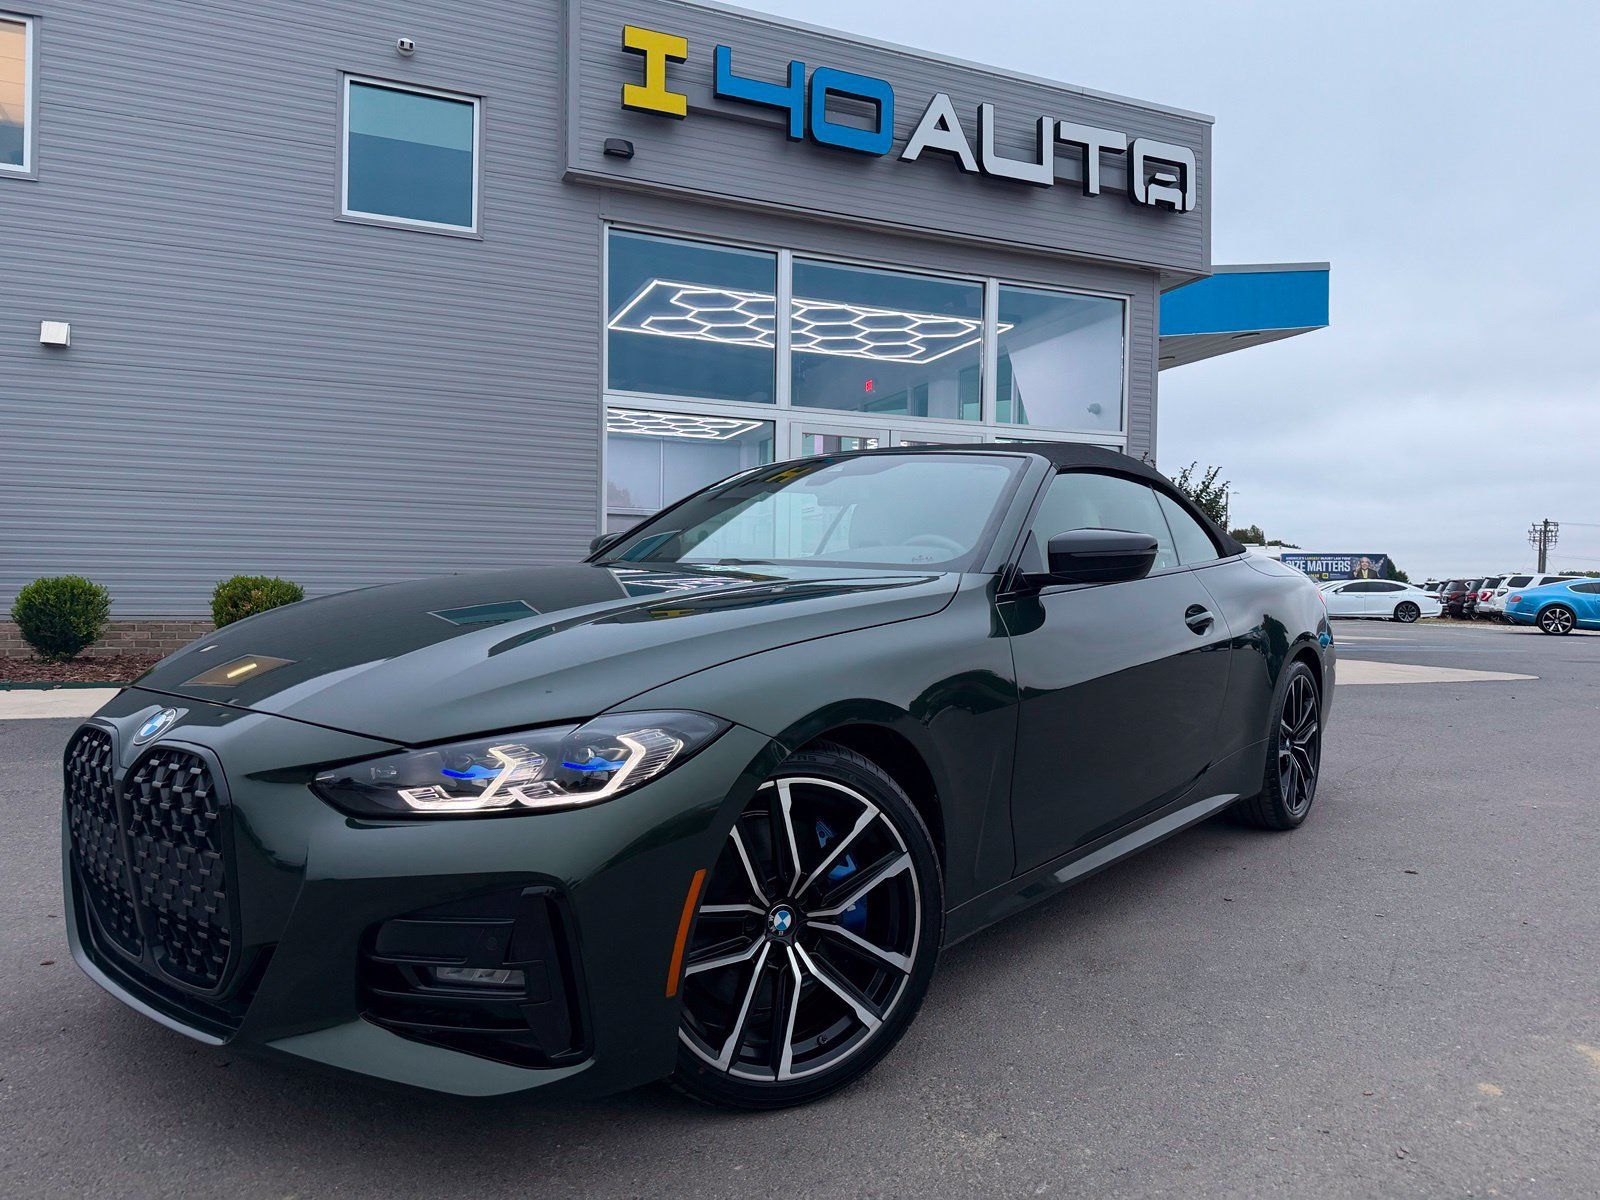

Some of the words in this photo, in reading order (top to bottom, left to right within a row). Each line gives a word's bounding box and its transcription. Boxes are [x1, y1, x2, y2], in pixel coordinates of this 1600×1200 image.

[622, 24, 688, 120] I
[713, 44, 895, 158] 40
[1307, 560, 1351, 571] MATTERS
